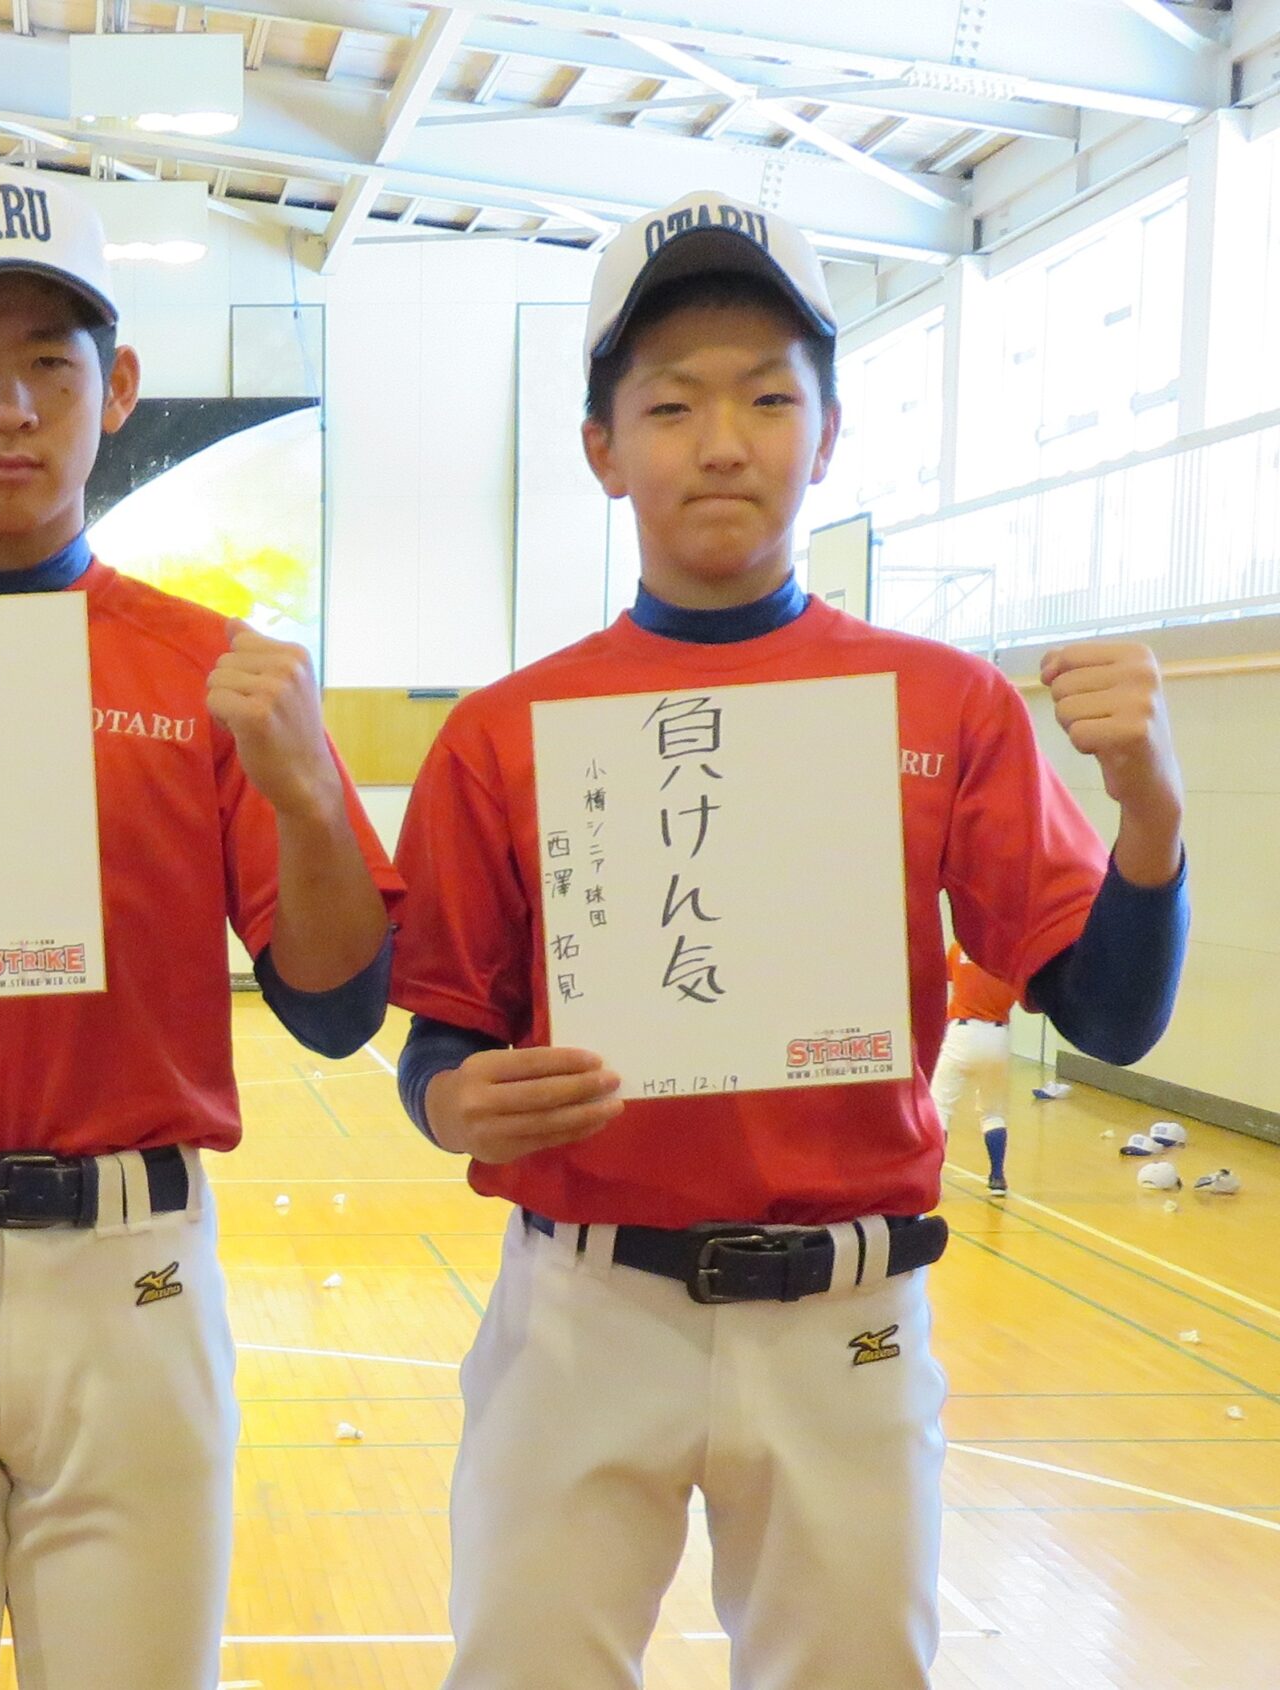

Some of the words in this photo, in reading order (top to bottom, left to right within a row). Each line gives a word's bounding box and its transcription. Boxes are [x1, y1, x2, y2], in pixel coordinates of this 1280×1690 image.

[641, 696, 726, 1004] 負けん気
[786, 1030, 892, 1067] STRIKE
